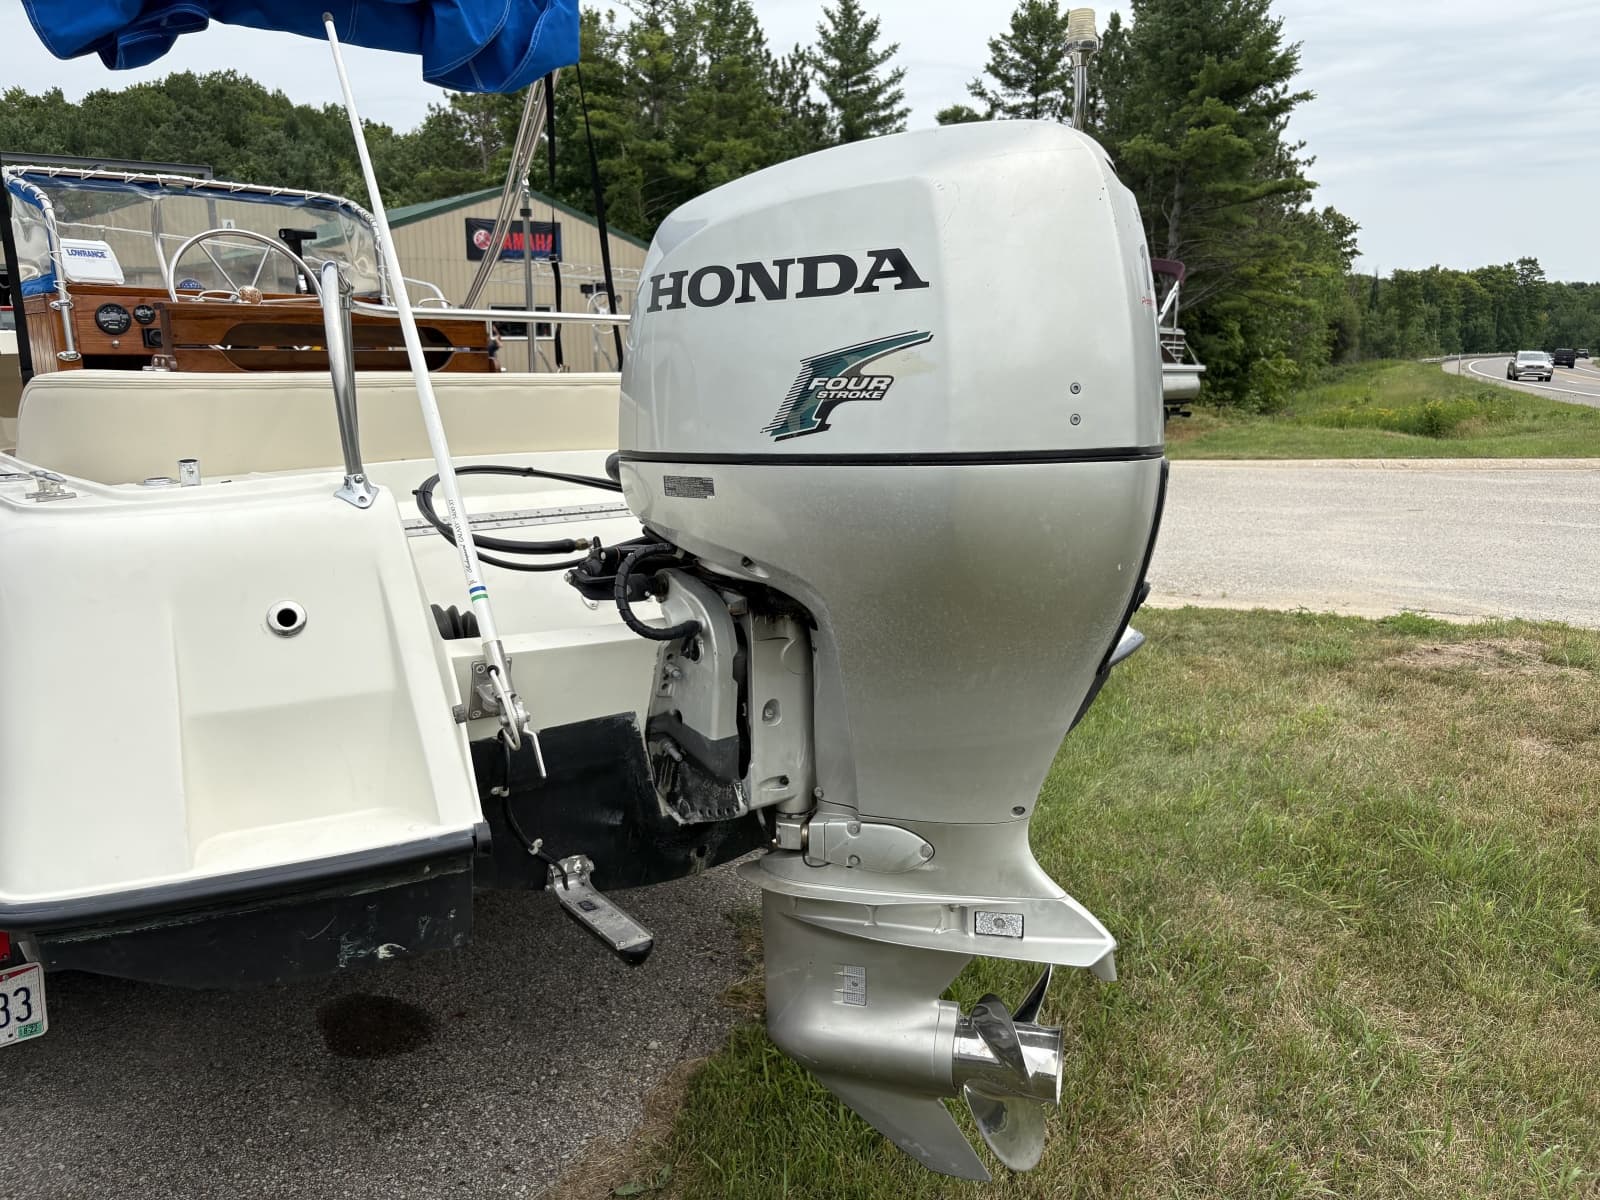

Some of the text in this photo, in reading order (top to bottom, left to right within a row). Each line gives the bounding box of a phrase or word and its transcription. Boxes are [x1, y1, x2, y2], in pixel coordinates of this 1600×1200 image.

[495, 232, 553, 251] AMAHA
[66, 249, 106, 258] LOWRANCE
[647, 247, 931, 314] HONDA
[808, 377, 892, 390] FOUR
[816, 390, 884, 399] STROKE
